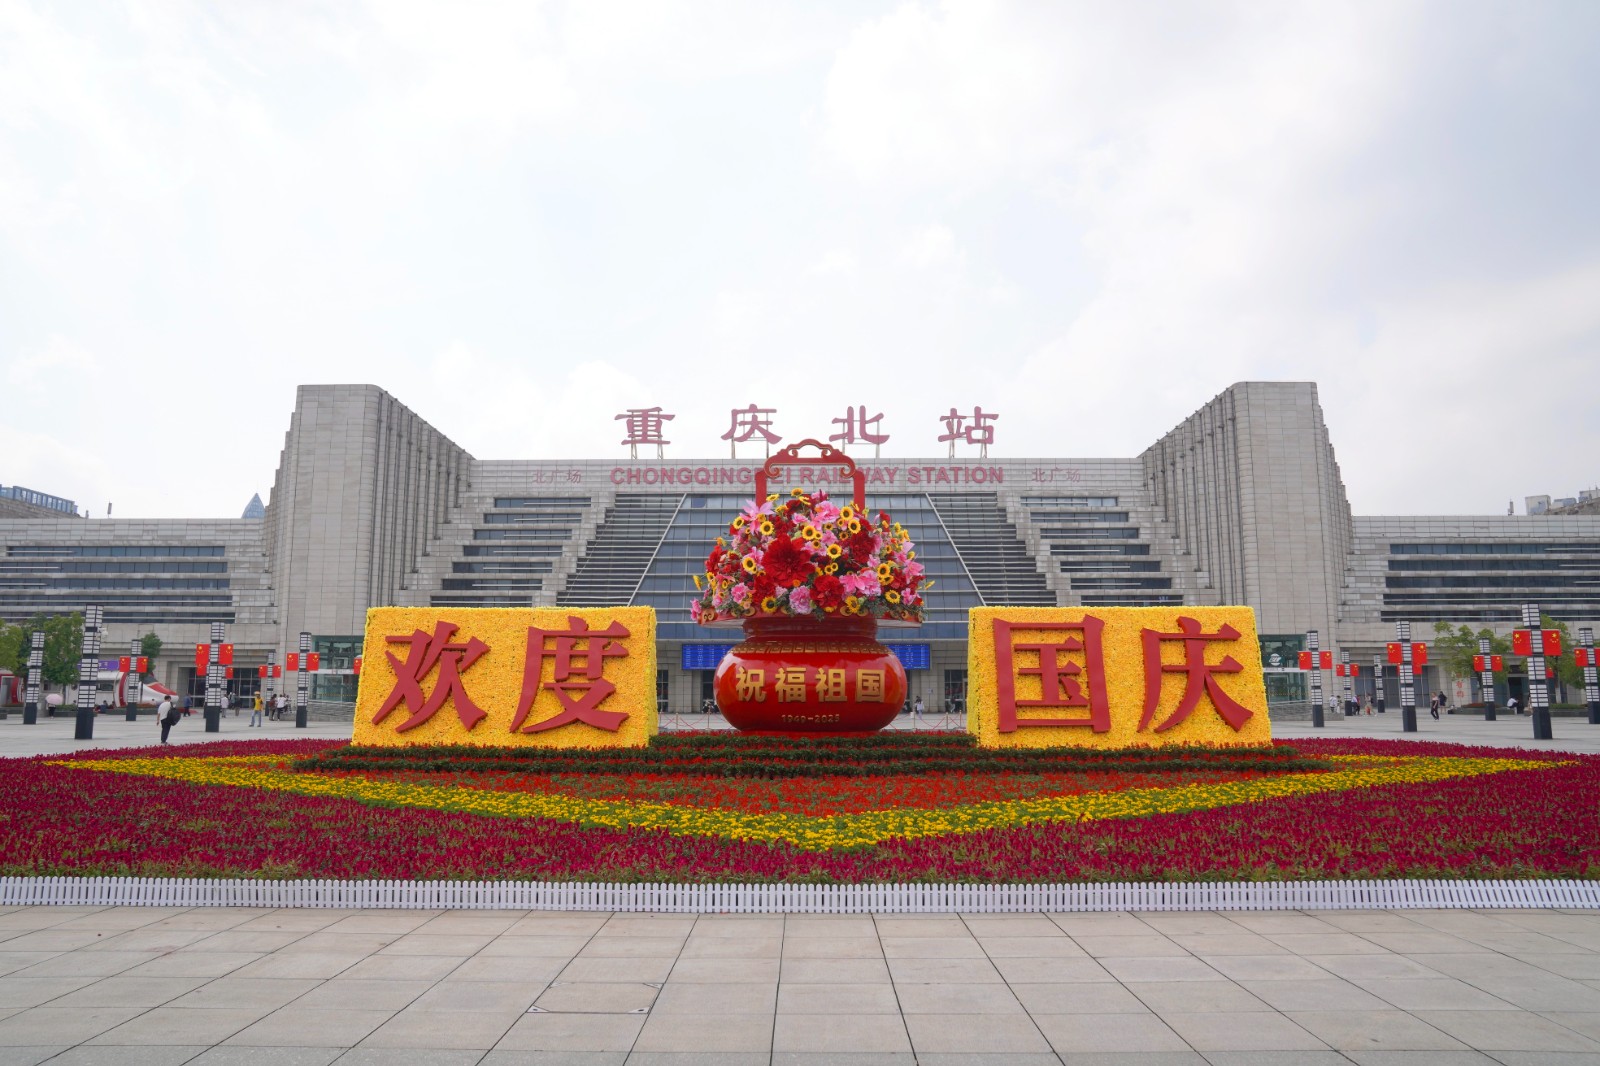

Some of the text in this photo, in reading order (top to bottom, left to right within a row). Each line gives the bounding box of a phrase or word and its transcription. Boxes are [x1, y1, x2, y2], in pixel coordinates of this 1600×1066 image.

[614, 403, 999, 445] 重庆北站
[532, 469, 582, 484] 北广场
[610, 467, 751, 485] CHONGQING
[907, 467, 1004, 484] STATION
[1031, 468, 1081, 483] 北广场
[372, 615, 631, 733] 欢度
[735, 666, 886, 703] 祝福祖国
[993, 614, 1254, 733] 国庆
